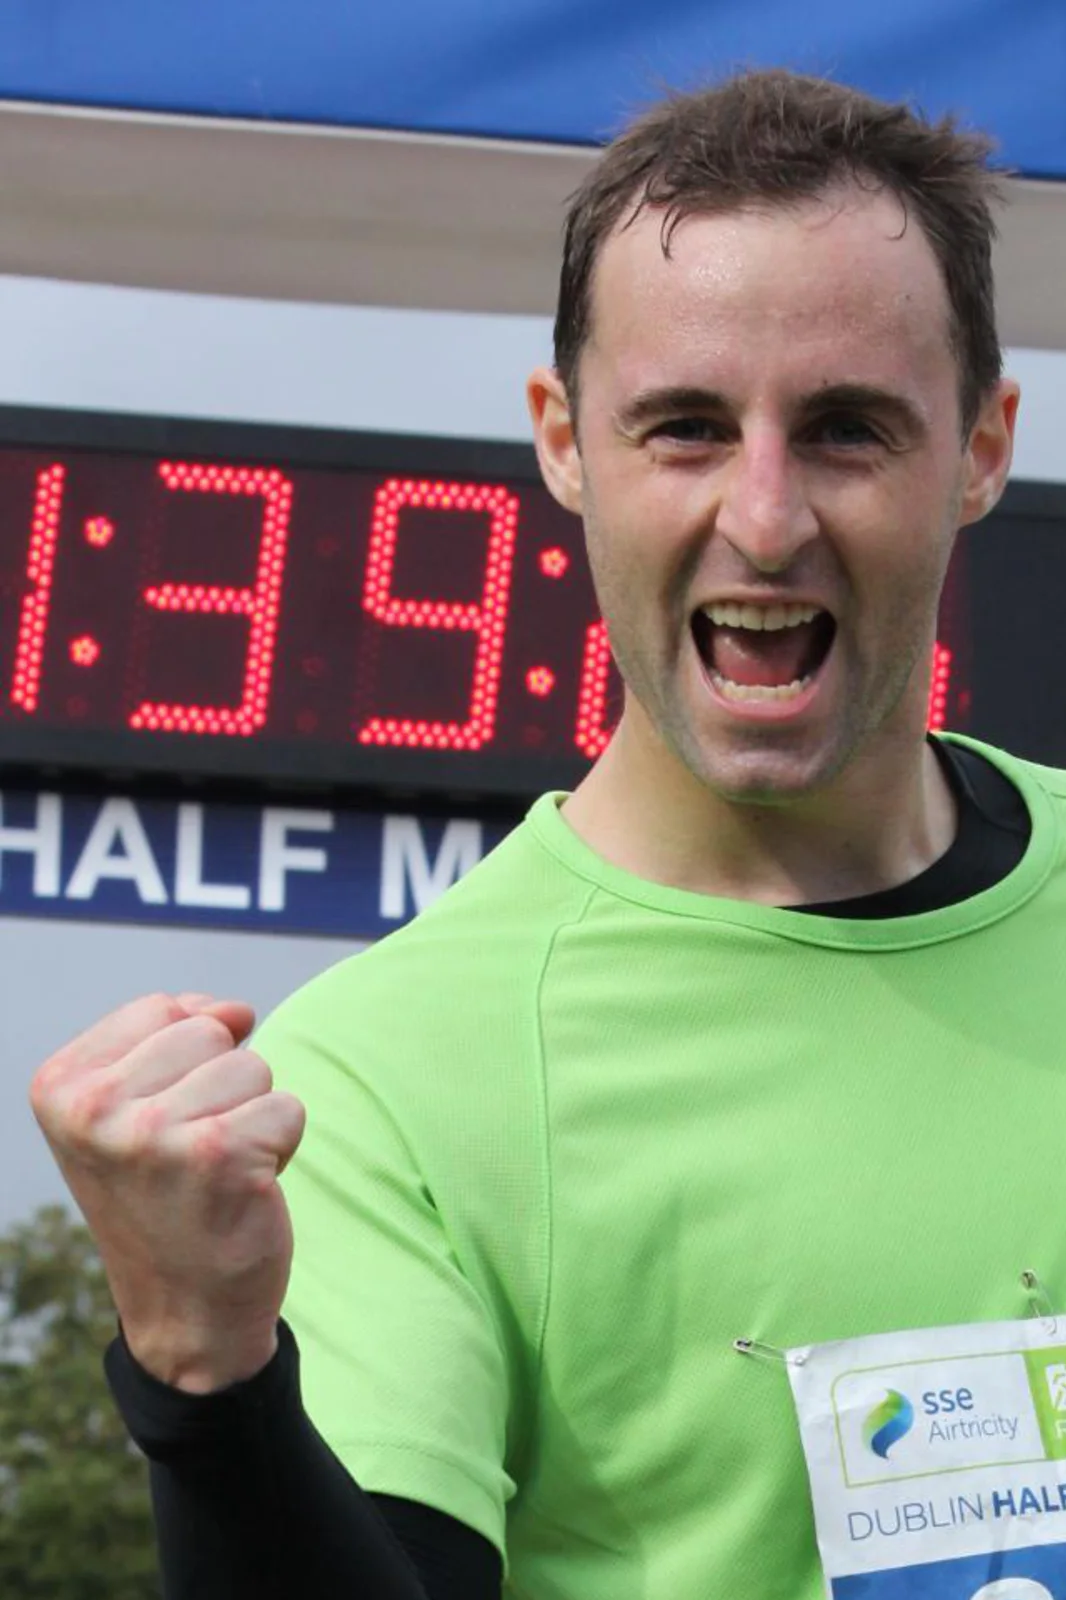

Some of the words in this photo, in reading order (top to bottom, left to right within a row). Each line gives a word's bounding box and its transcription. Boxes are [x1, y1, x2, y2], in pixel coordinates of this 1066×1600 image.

[12, 462, 610, 760] 1:39:
[379, 815, 483, 918] M
[922, 1387, 974, 1414] sse
[928, 1414, 1018, 1443] Airtricity
[847, 1493, 984, 1541] DUBLIN
